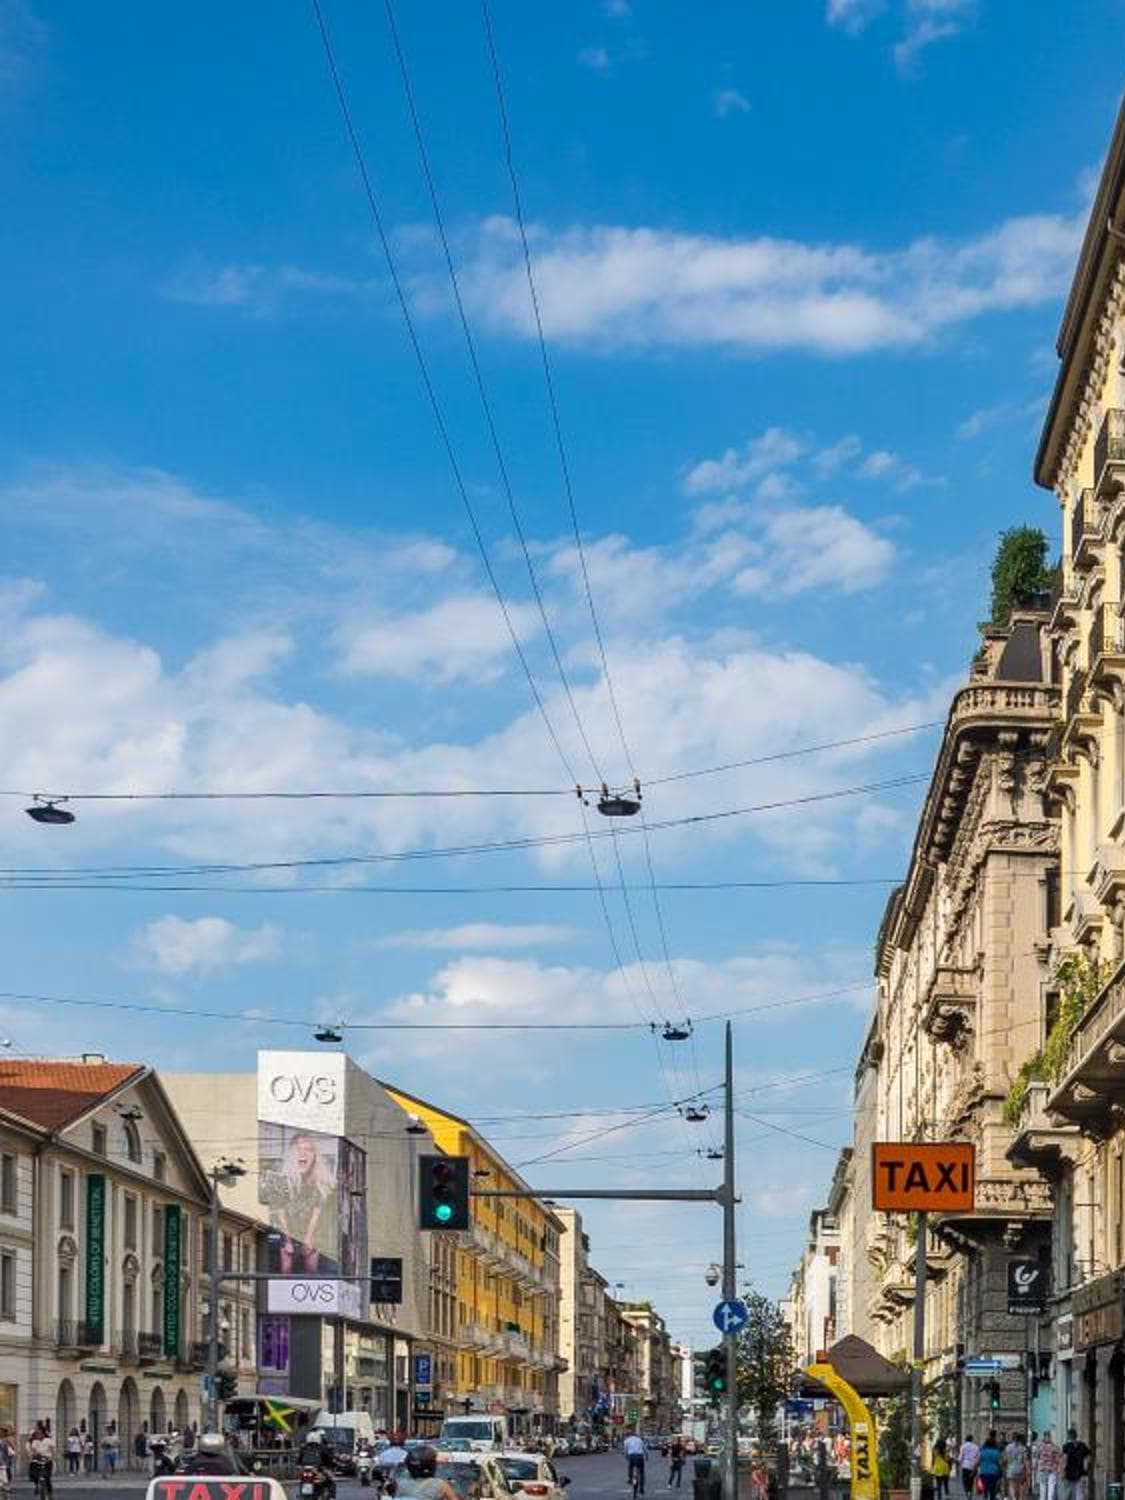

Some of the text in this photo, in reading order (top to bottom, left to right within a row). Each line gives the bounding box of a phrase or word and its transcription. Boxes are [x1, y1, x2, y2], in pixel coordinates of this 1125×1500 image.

[270, 1074, 337, 1105] OVS
[879, 1161, 969, 1194] TAXI
[291, 1283, 335, 1303] OVS
[855, 1435, 870, 1481] TAXI
